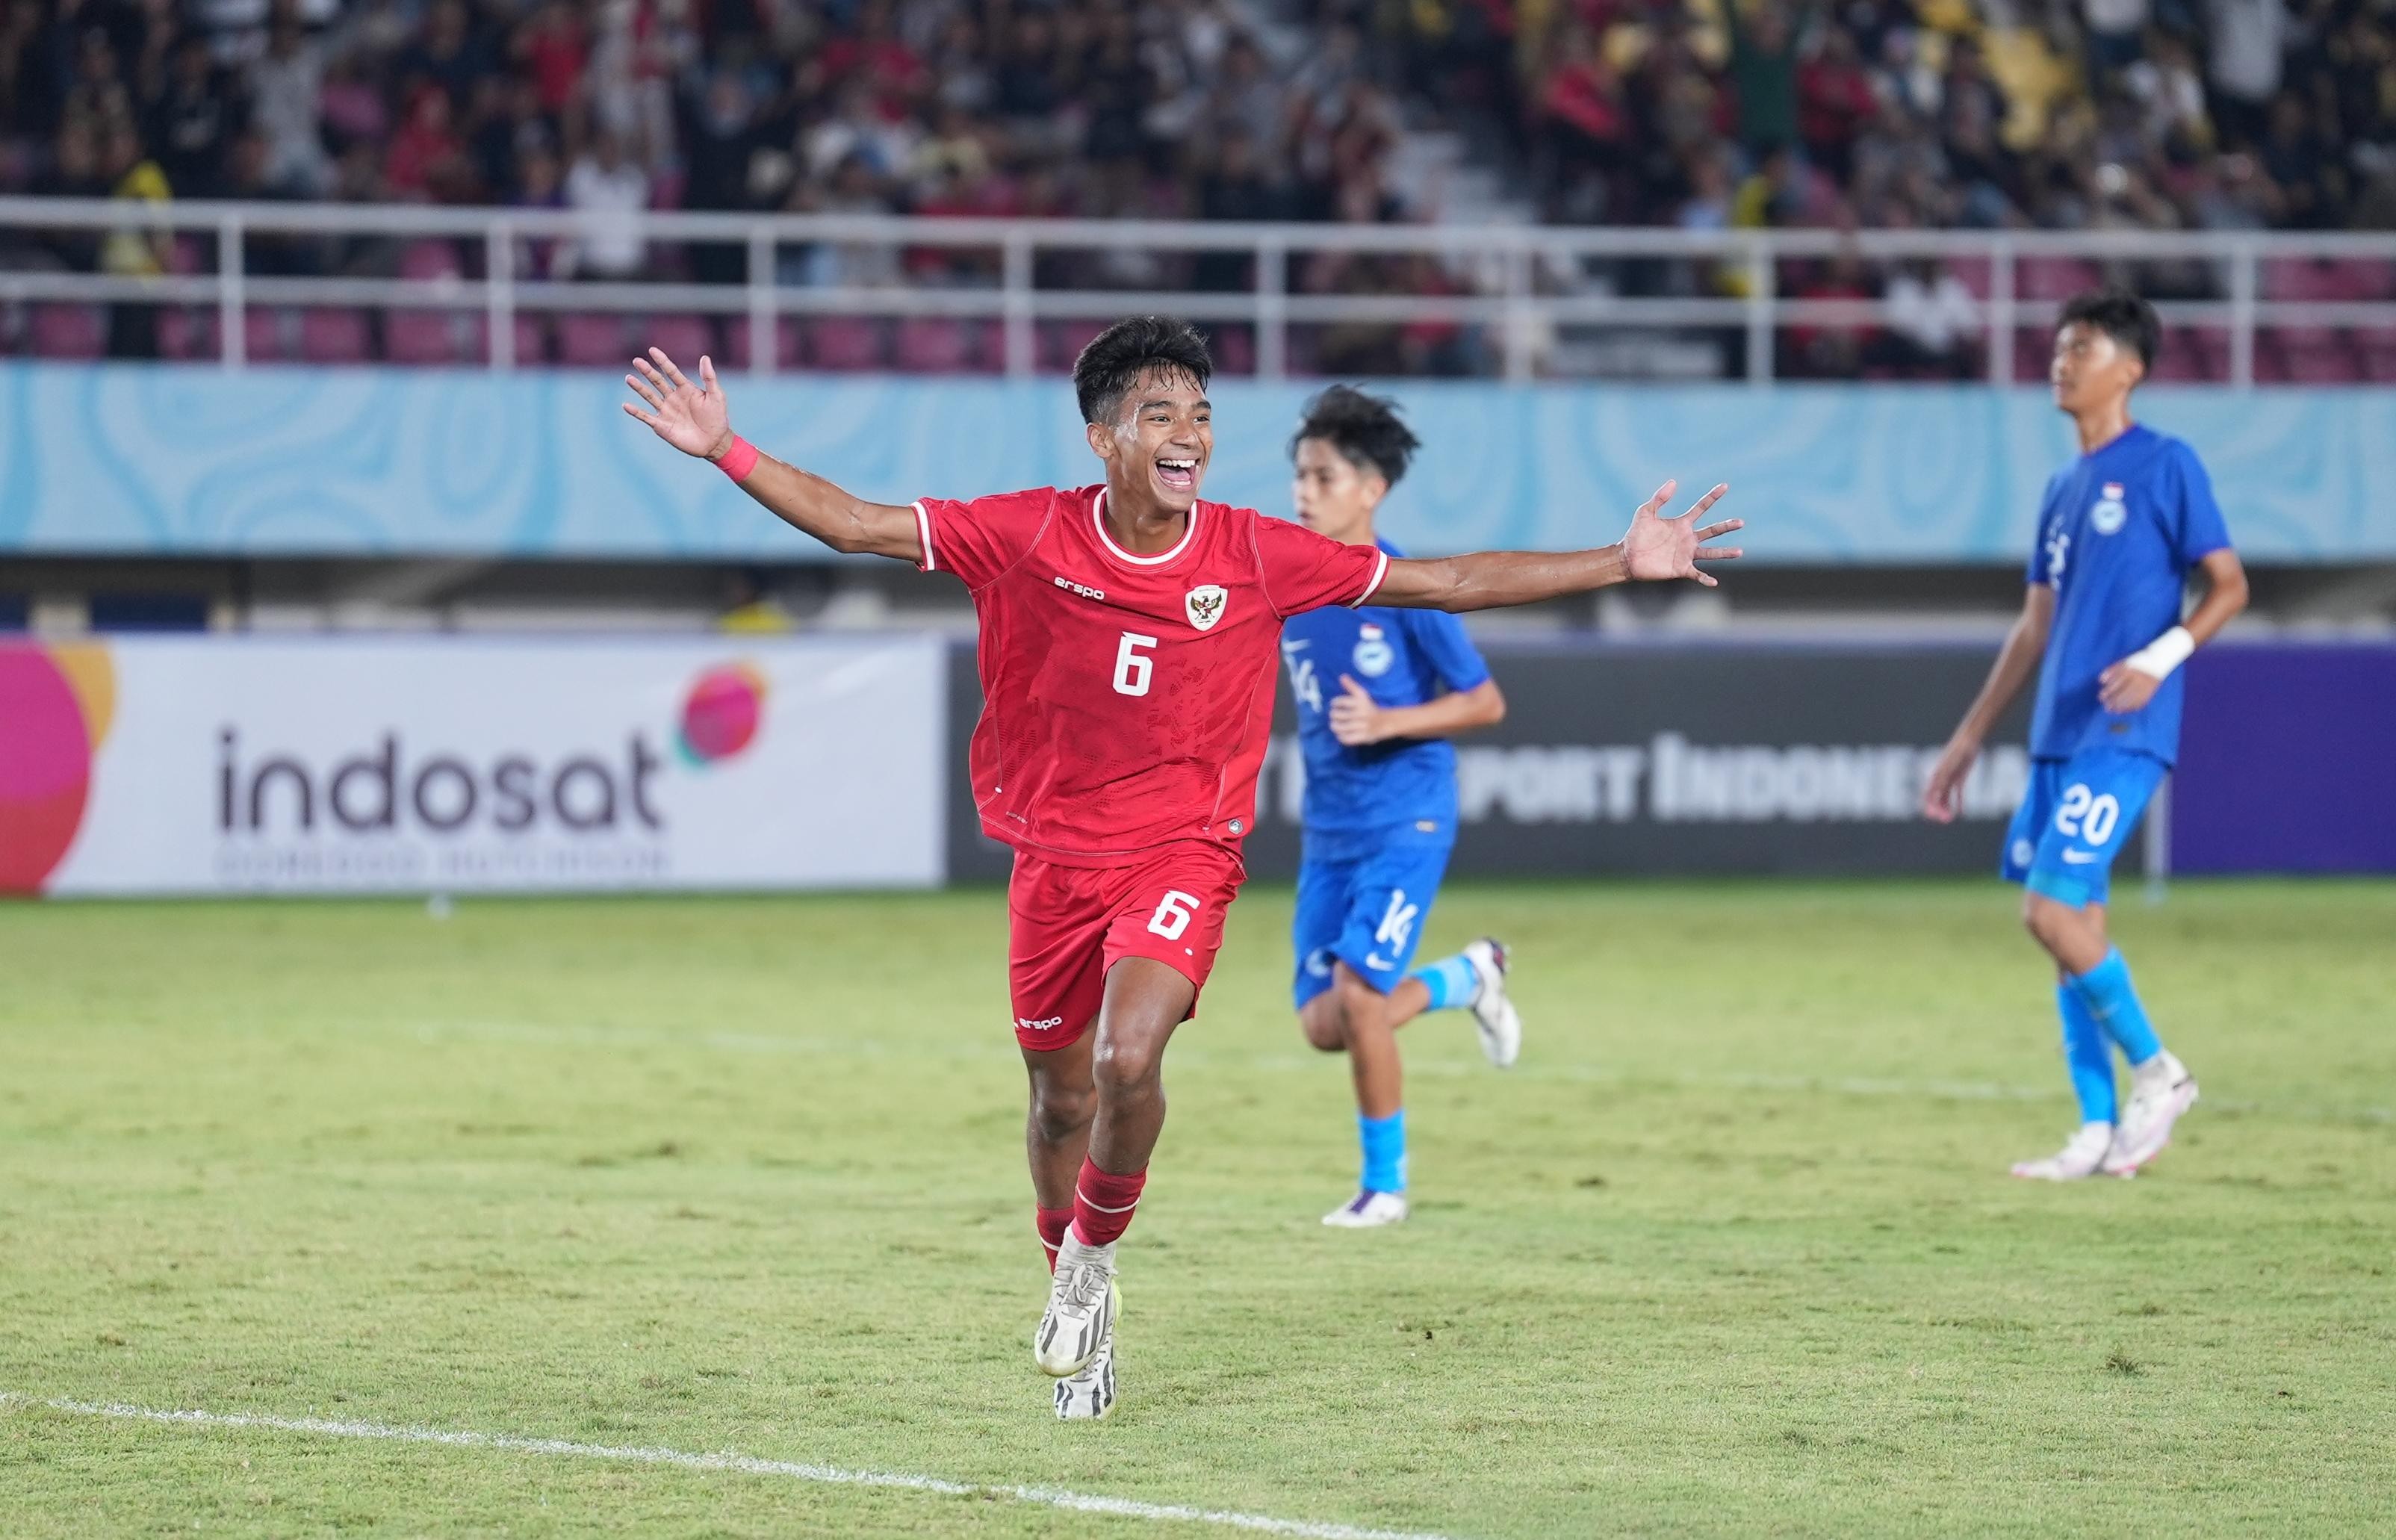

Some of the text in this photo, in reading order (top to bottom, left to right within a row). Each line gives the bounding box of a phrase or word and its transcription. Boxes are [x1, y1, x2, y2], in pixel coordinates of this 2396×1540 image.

[1054, 577, 1105, 600] erspo
[1112, 630, 1158, 697] 6
[1284, 651, 1323, 713] 14
[219, 727, 663, 832] indosat
[1457, 745, 1642, 821] PORT
[2056, 783, 2120, 846] 20
[1147, 889, 1201, 940] 6
[1376, 888, 1419, 958] 14
[1019, 1016, 1063, 1031] erspo
